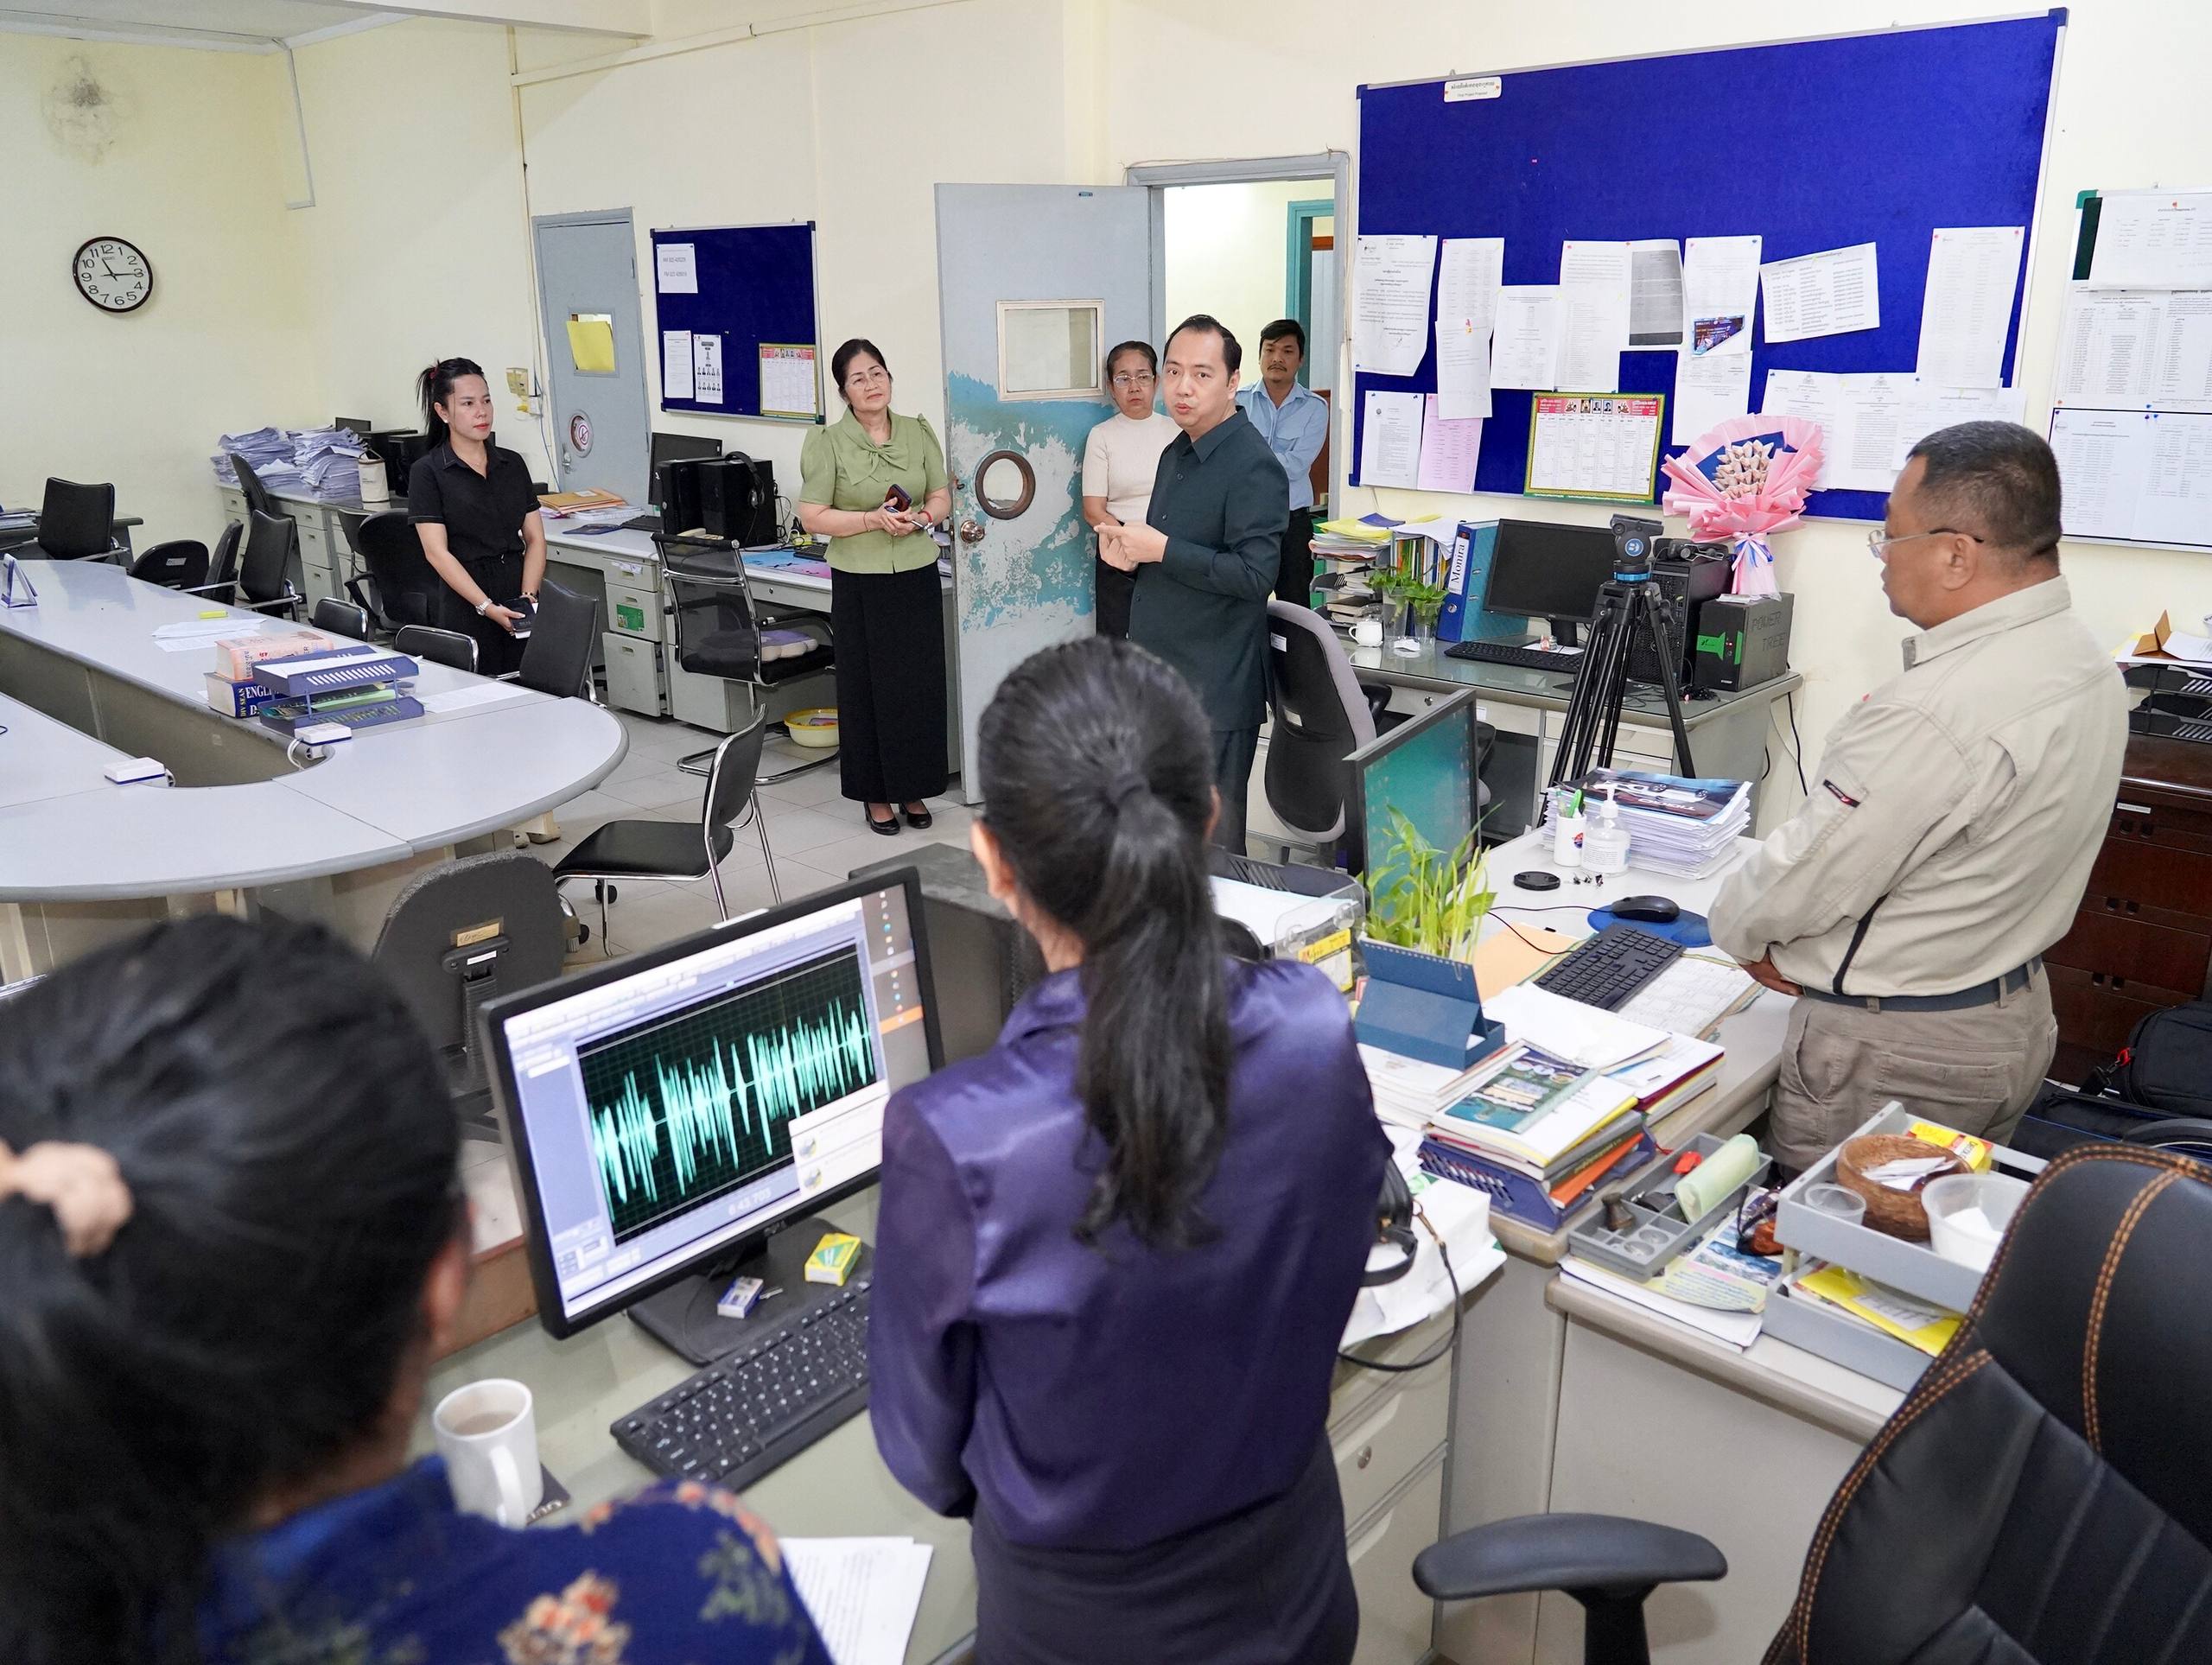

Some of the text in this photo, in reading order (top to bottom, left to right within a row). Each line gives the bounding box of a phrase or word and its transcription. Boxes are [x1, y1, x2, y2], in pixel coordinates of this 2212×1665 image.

[90, 248, 99, 257] 11
[100, 245, 114, 254] 12
[118, 246, 123, 256] 1
[82, 258, 95, 269] 10
[127, 256, 137, 265] 2
[81, 272, 92, 282] 9
[134, 268, 143, 277] 3
[88, 285, 99, 295] 8
[134, 282, 143, 290] 4
[99, 294, 109, 303] 7
[114, 296, 124, 305] 6
[126, 291, 137, 301] 5
[1751, 610, 1783, 632] POWER
